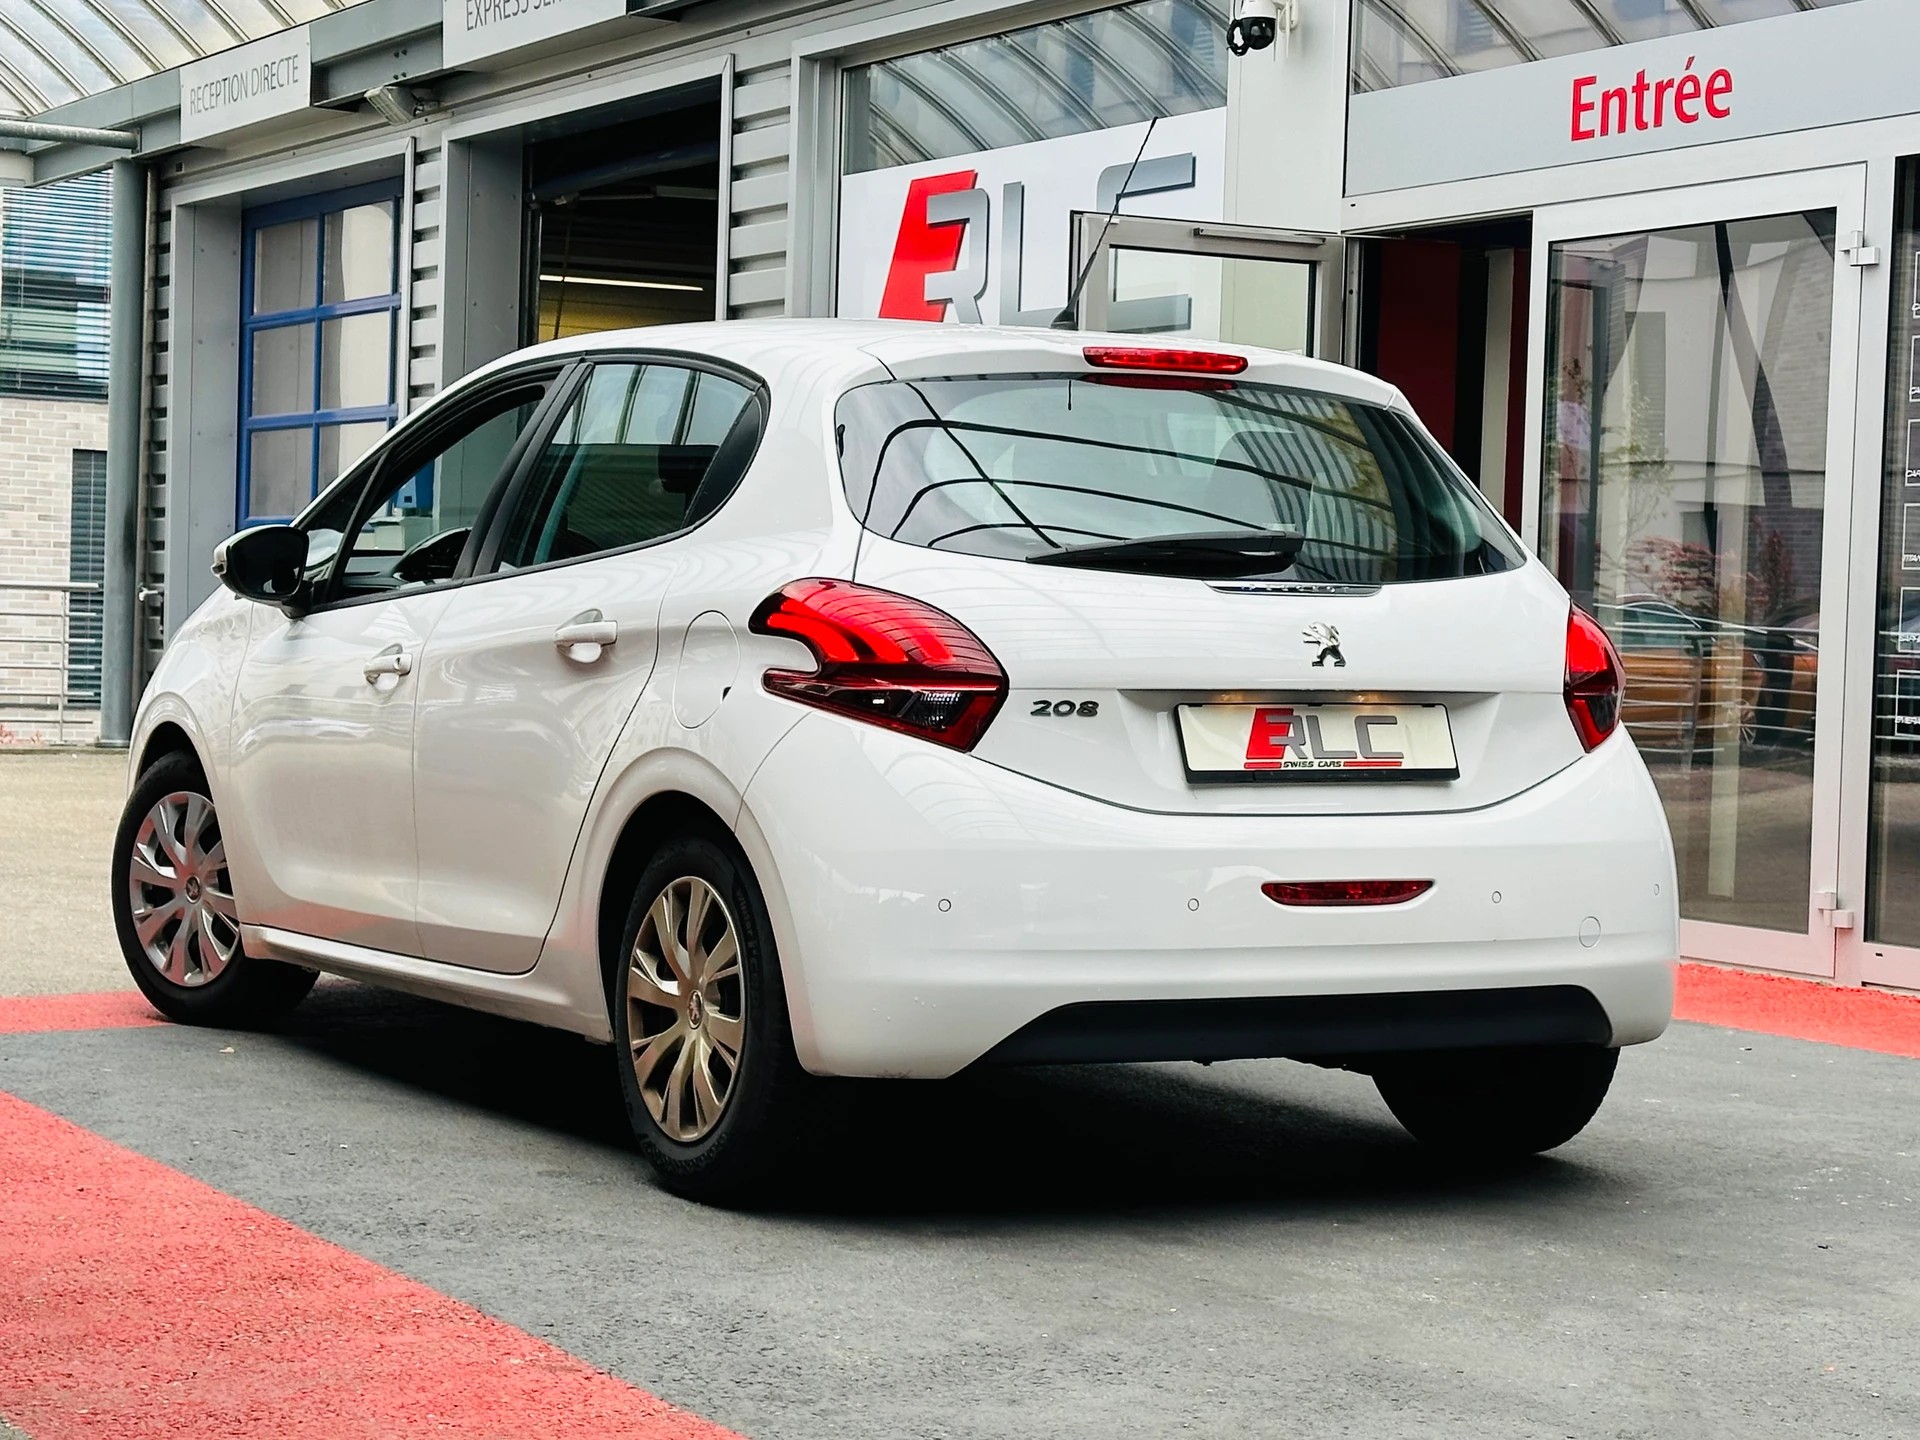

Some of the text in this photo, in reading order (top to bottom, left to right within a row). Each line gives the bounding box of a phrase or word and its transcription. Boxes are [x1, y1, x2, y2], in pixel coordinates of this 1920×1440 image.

[190, 54, 299, 116] RECEPTION DIRECTE
[1571, 56, 1733, 141] Entrée
[1030, 699, 1099, 717] 208
